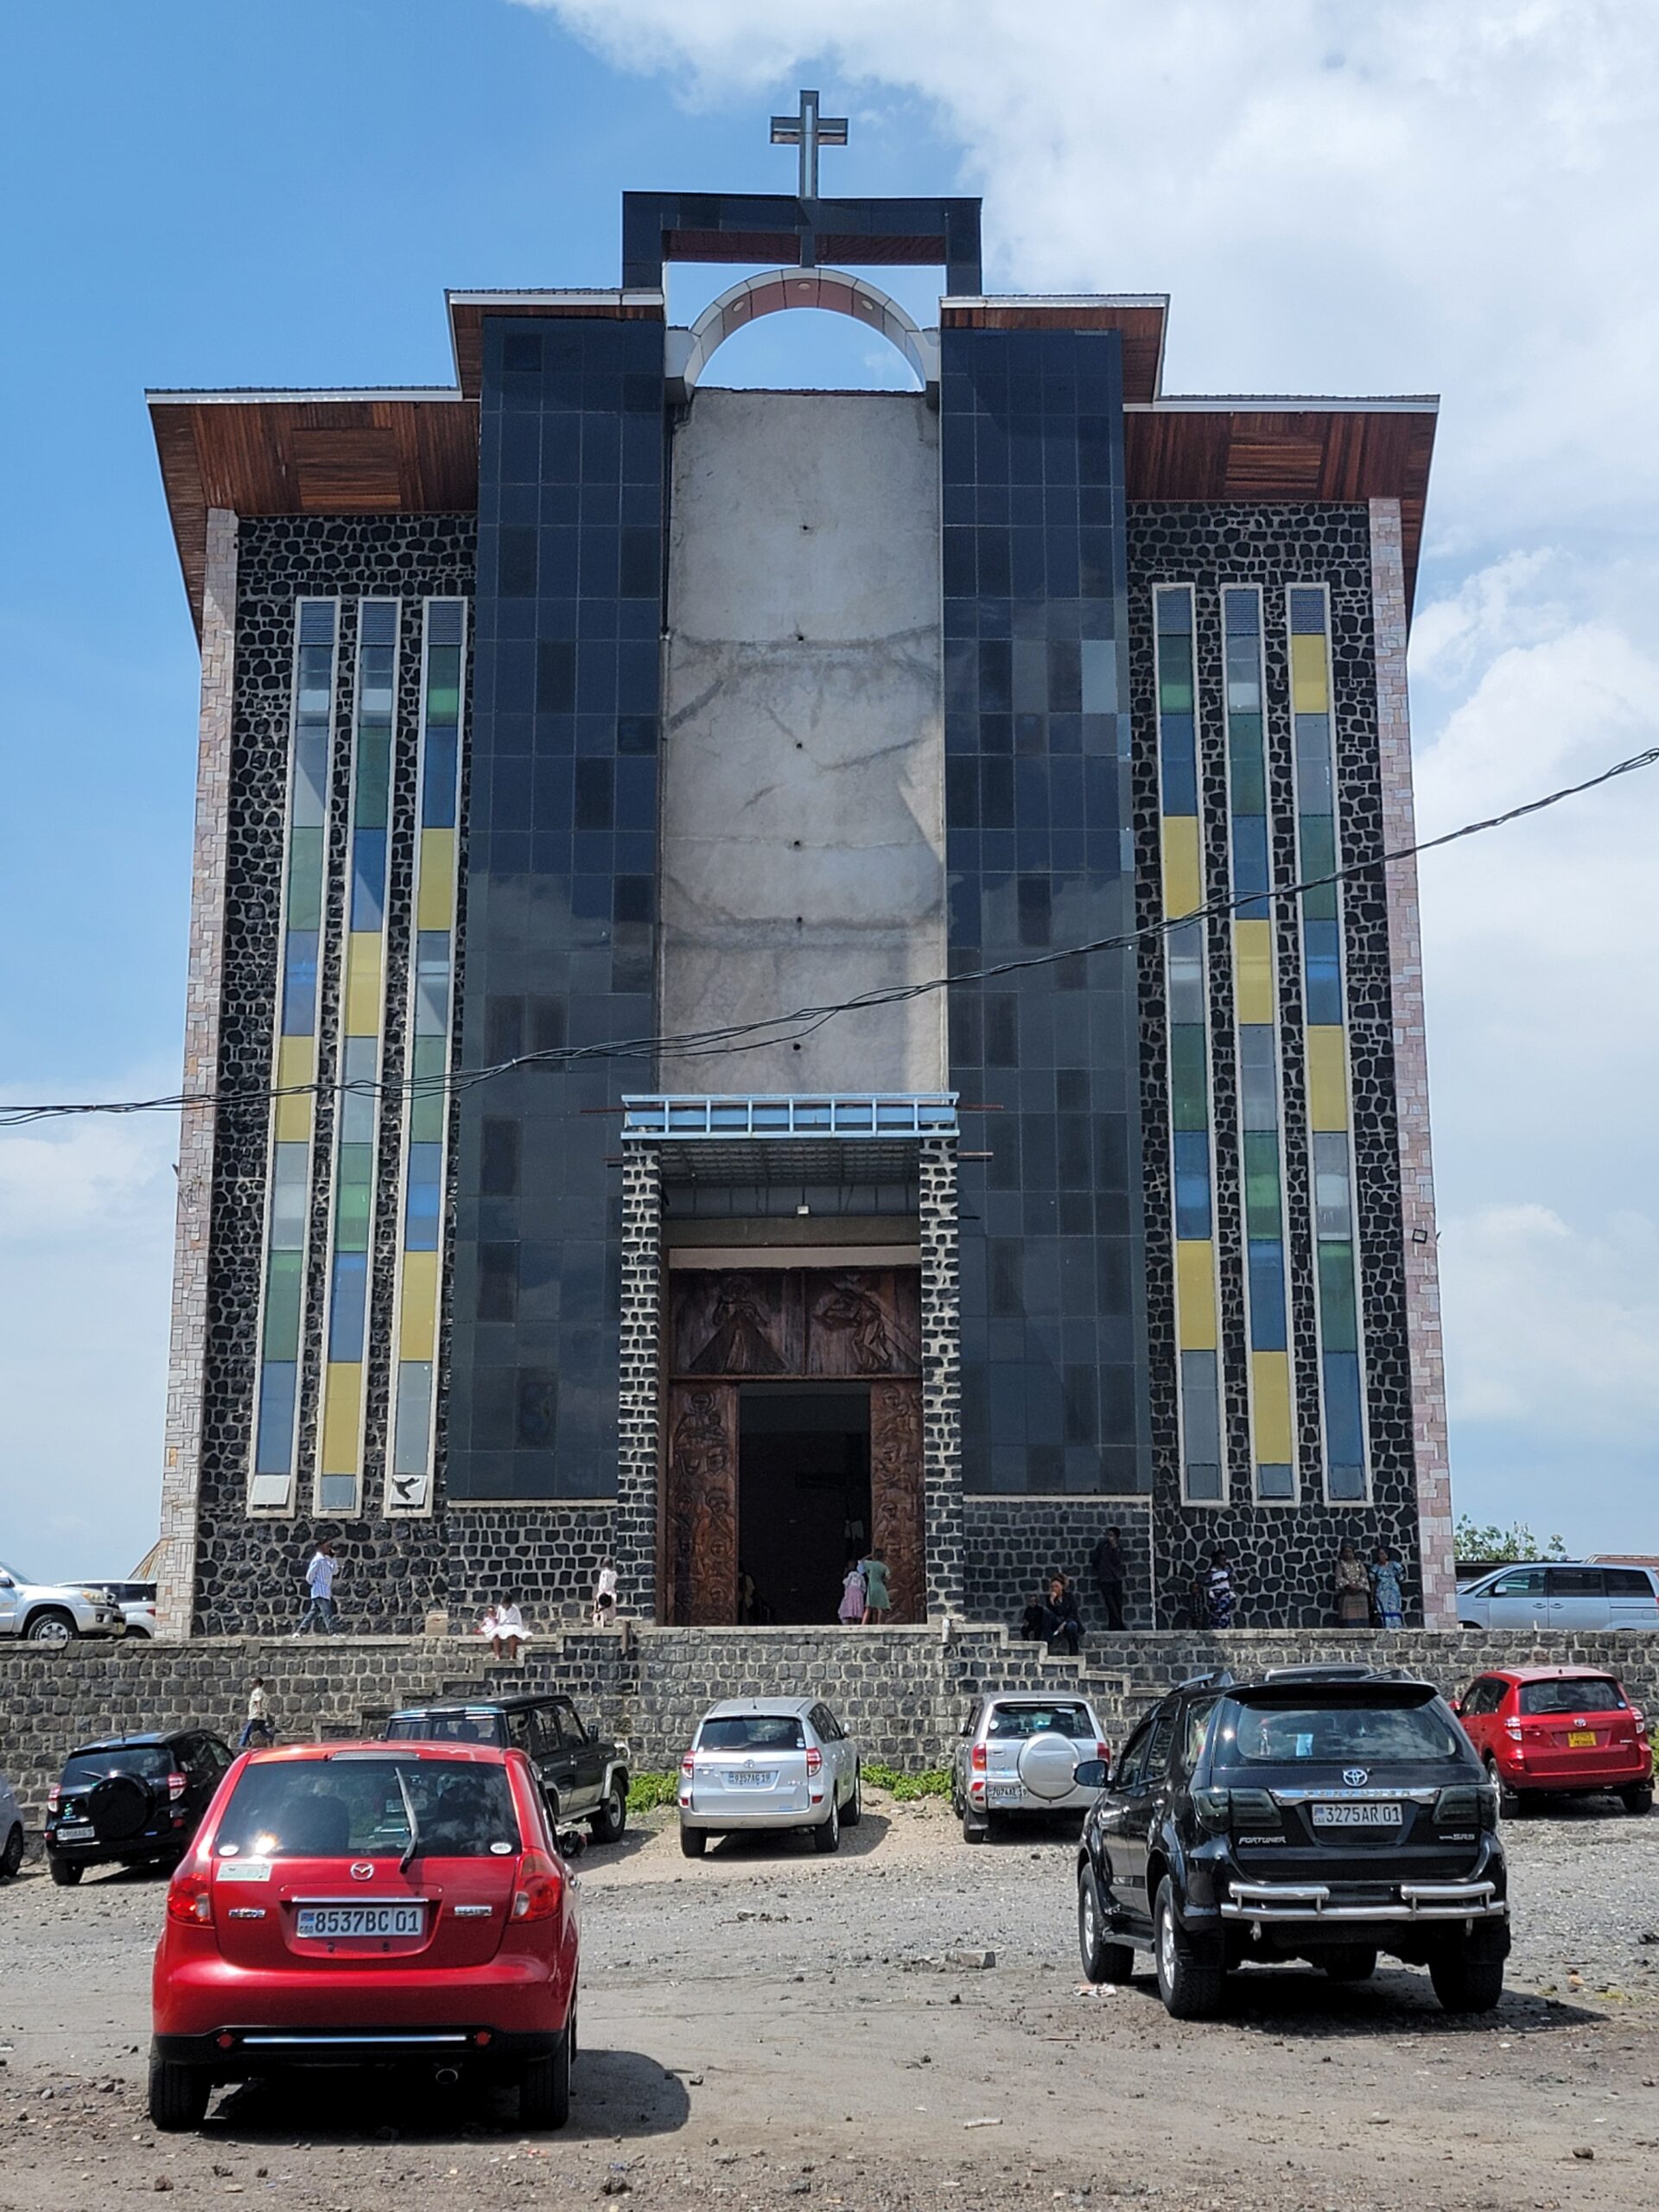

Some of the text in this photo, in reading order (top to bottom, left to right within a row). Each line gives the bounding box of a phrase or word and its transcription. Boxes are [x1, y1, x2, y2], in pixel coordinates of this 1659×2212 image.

[1325, 1806, 1401, 1823] 3275AR 01
[1238, 1836, 1287, 1845] FORTUNER
[315, 1910, 419, 1933] 8537BC 01
